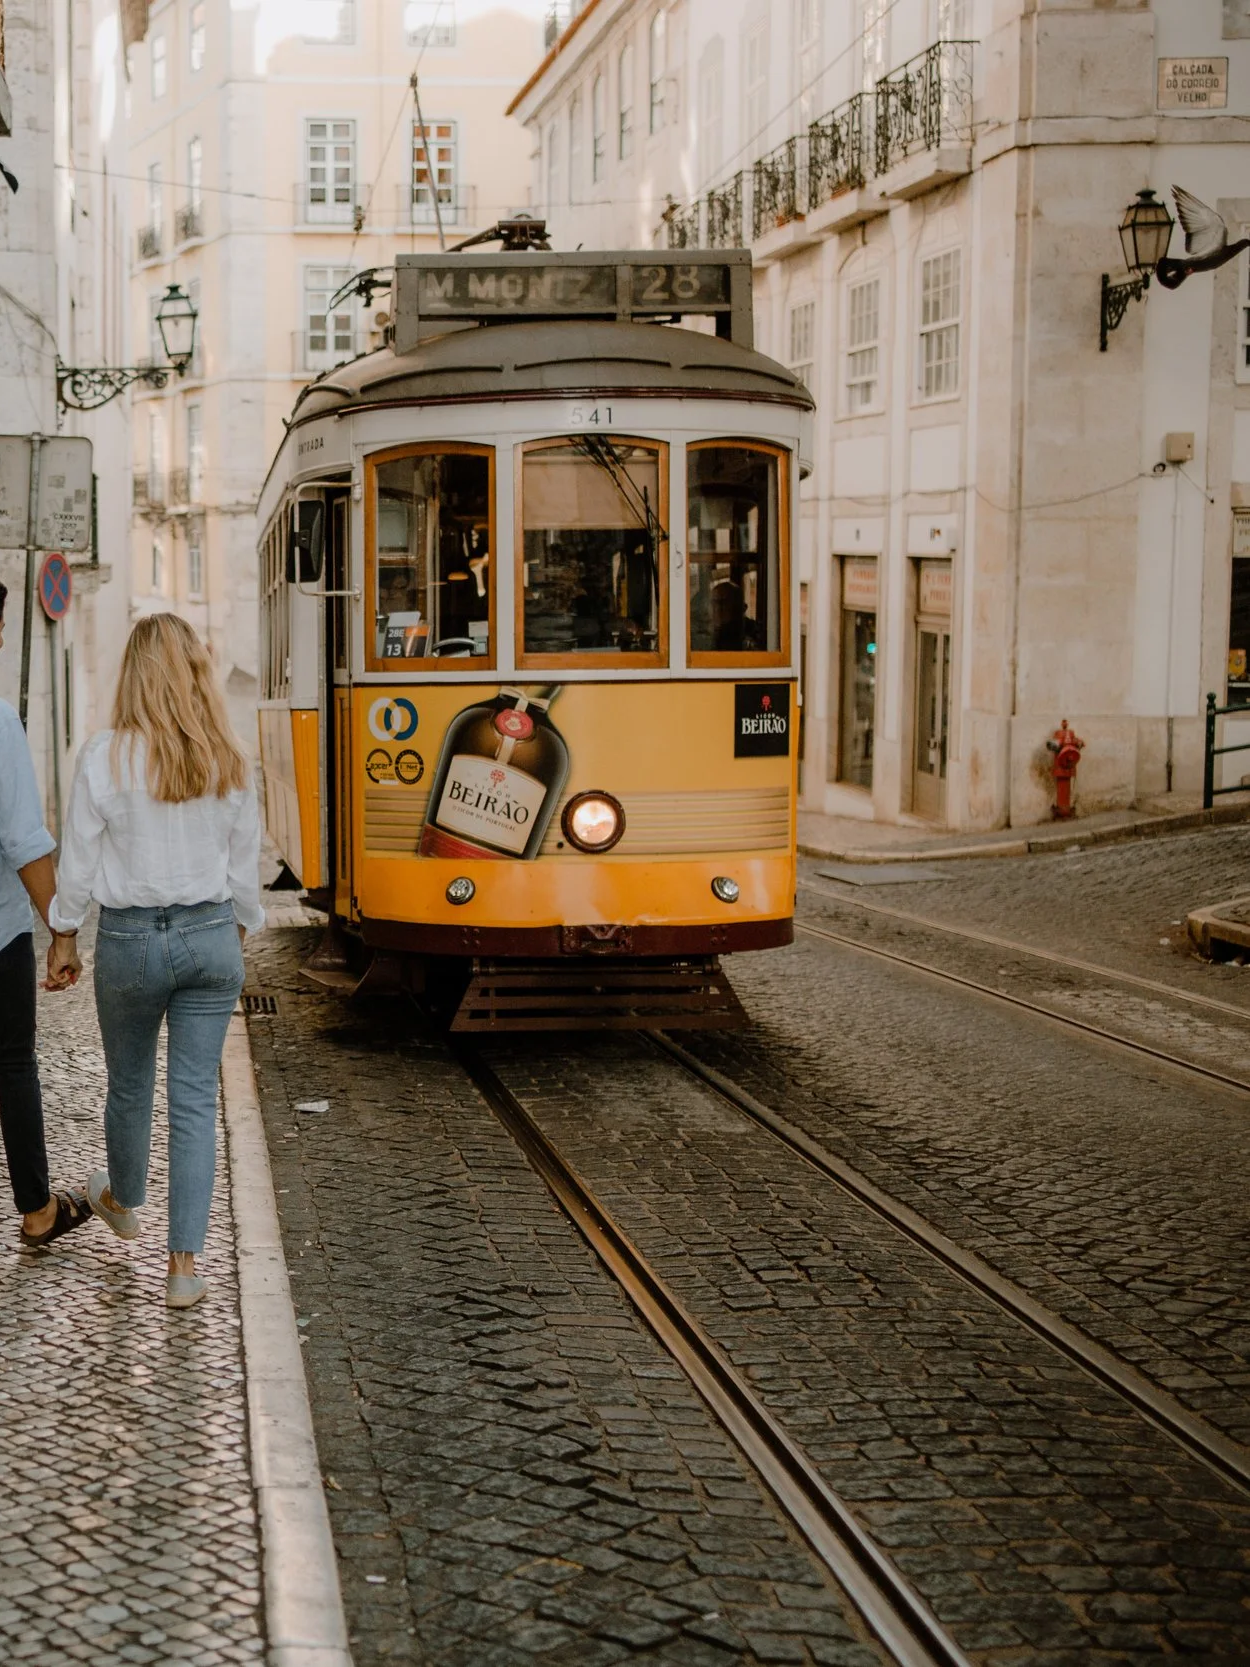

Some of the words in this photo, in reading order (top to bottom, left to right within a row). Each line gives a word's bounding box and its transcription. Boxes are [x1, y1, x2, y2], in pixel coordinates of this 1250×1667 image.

[1166, 78, 1178, 89] DO
[1177, 92, 1207, 103] VELHO
[426, 272, 459, 298] M.
[642, 266, 699, 300] 28
[570, 407, 612, 425] 541
[386, 643, 402, 656] 13
[741, 716, 787, 735] BEIRÃO
[449, 780, 529, 824] BEIRÃO
